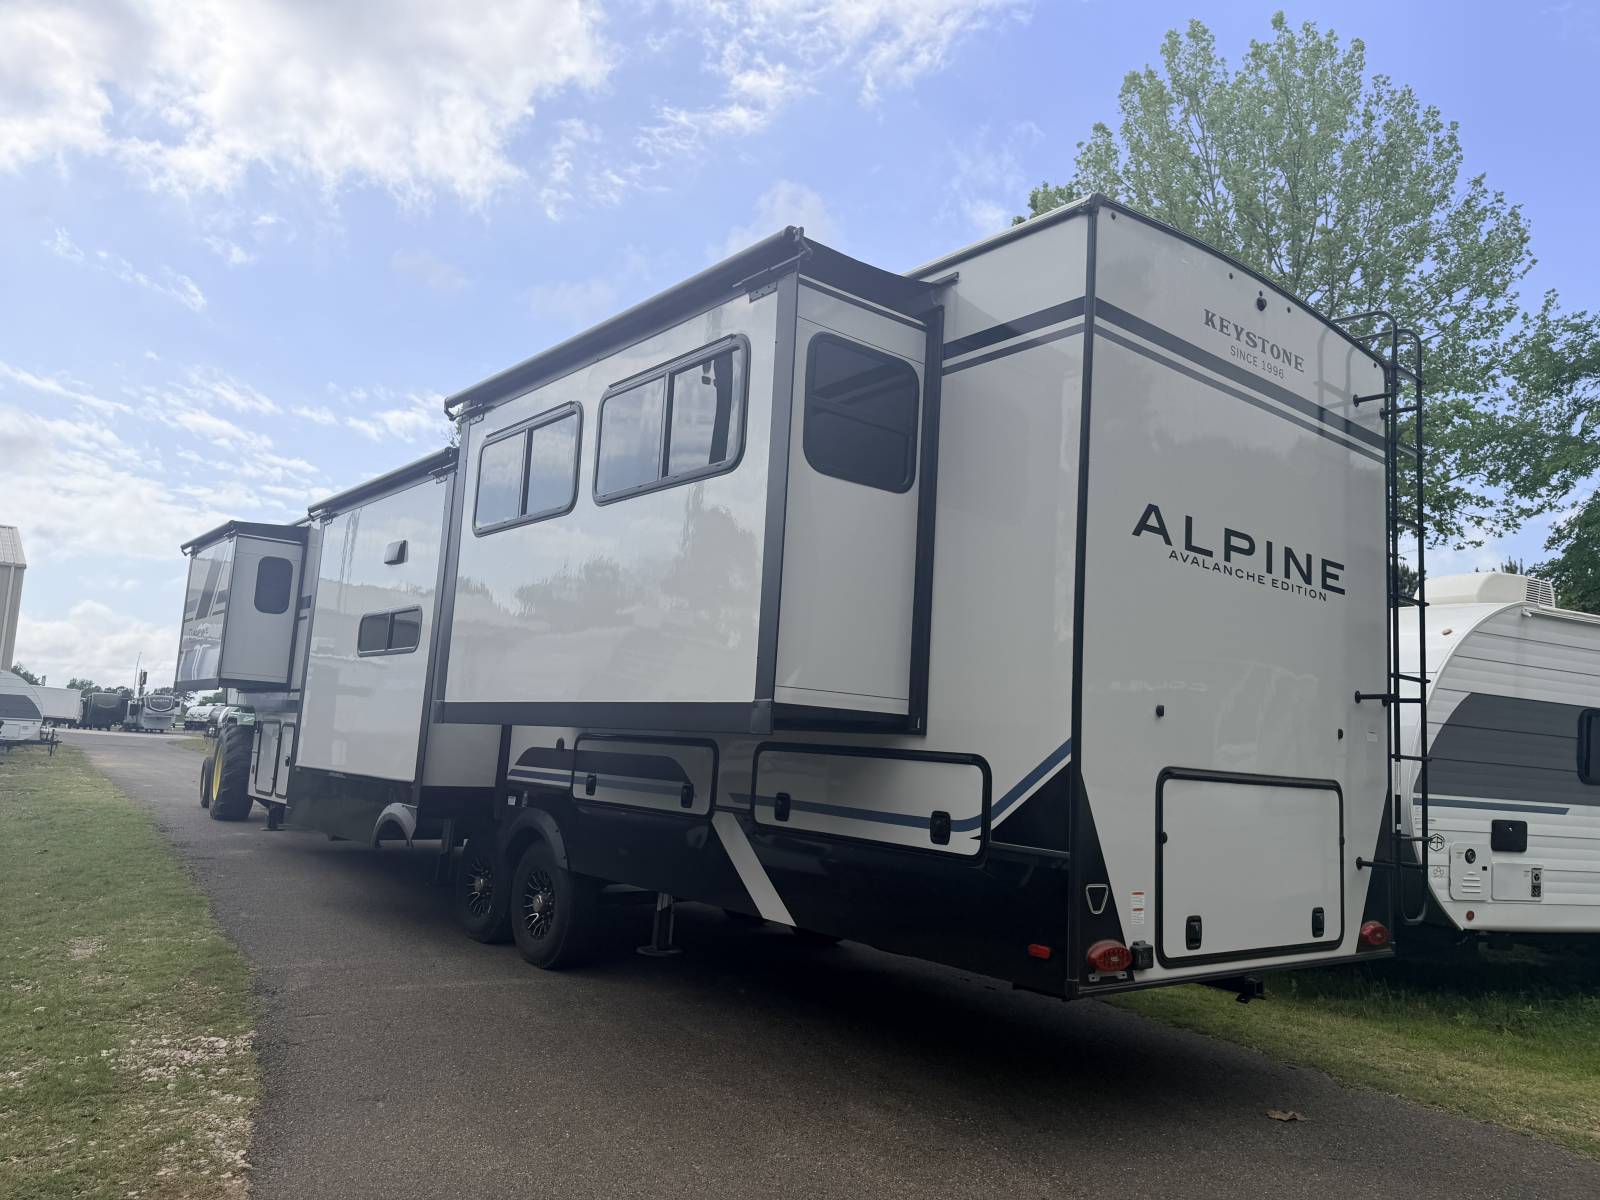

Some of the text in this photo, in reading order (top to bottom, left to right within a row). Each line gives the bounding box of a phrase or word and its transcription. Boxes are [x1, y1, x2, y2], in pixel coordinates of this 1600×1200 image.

[1203, 308, 1305, 373] KEYSTONE
[1230, 344, 1258, 368] SINCE
[1131, 502, 1346, 596] ALPINE
[1168, 549, 1328, 602] AVALANCHE EDITION
